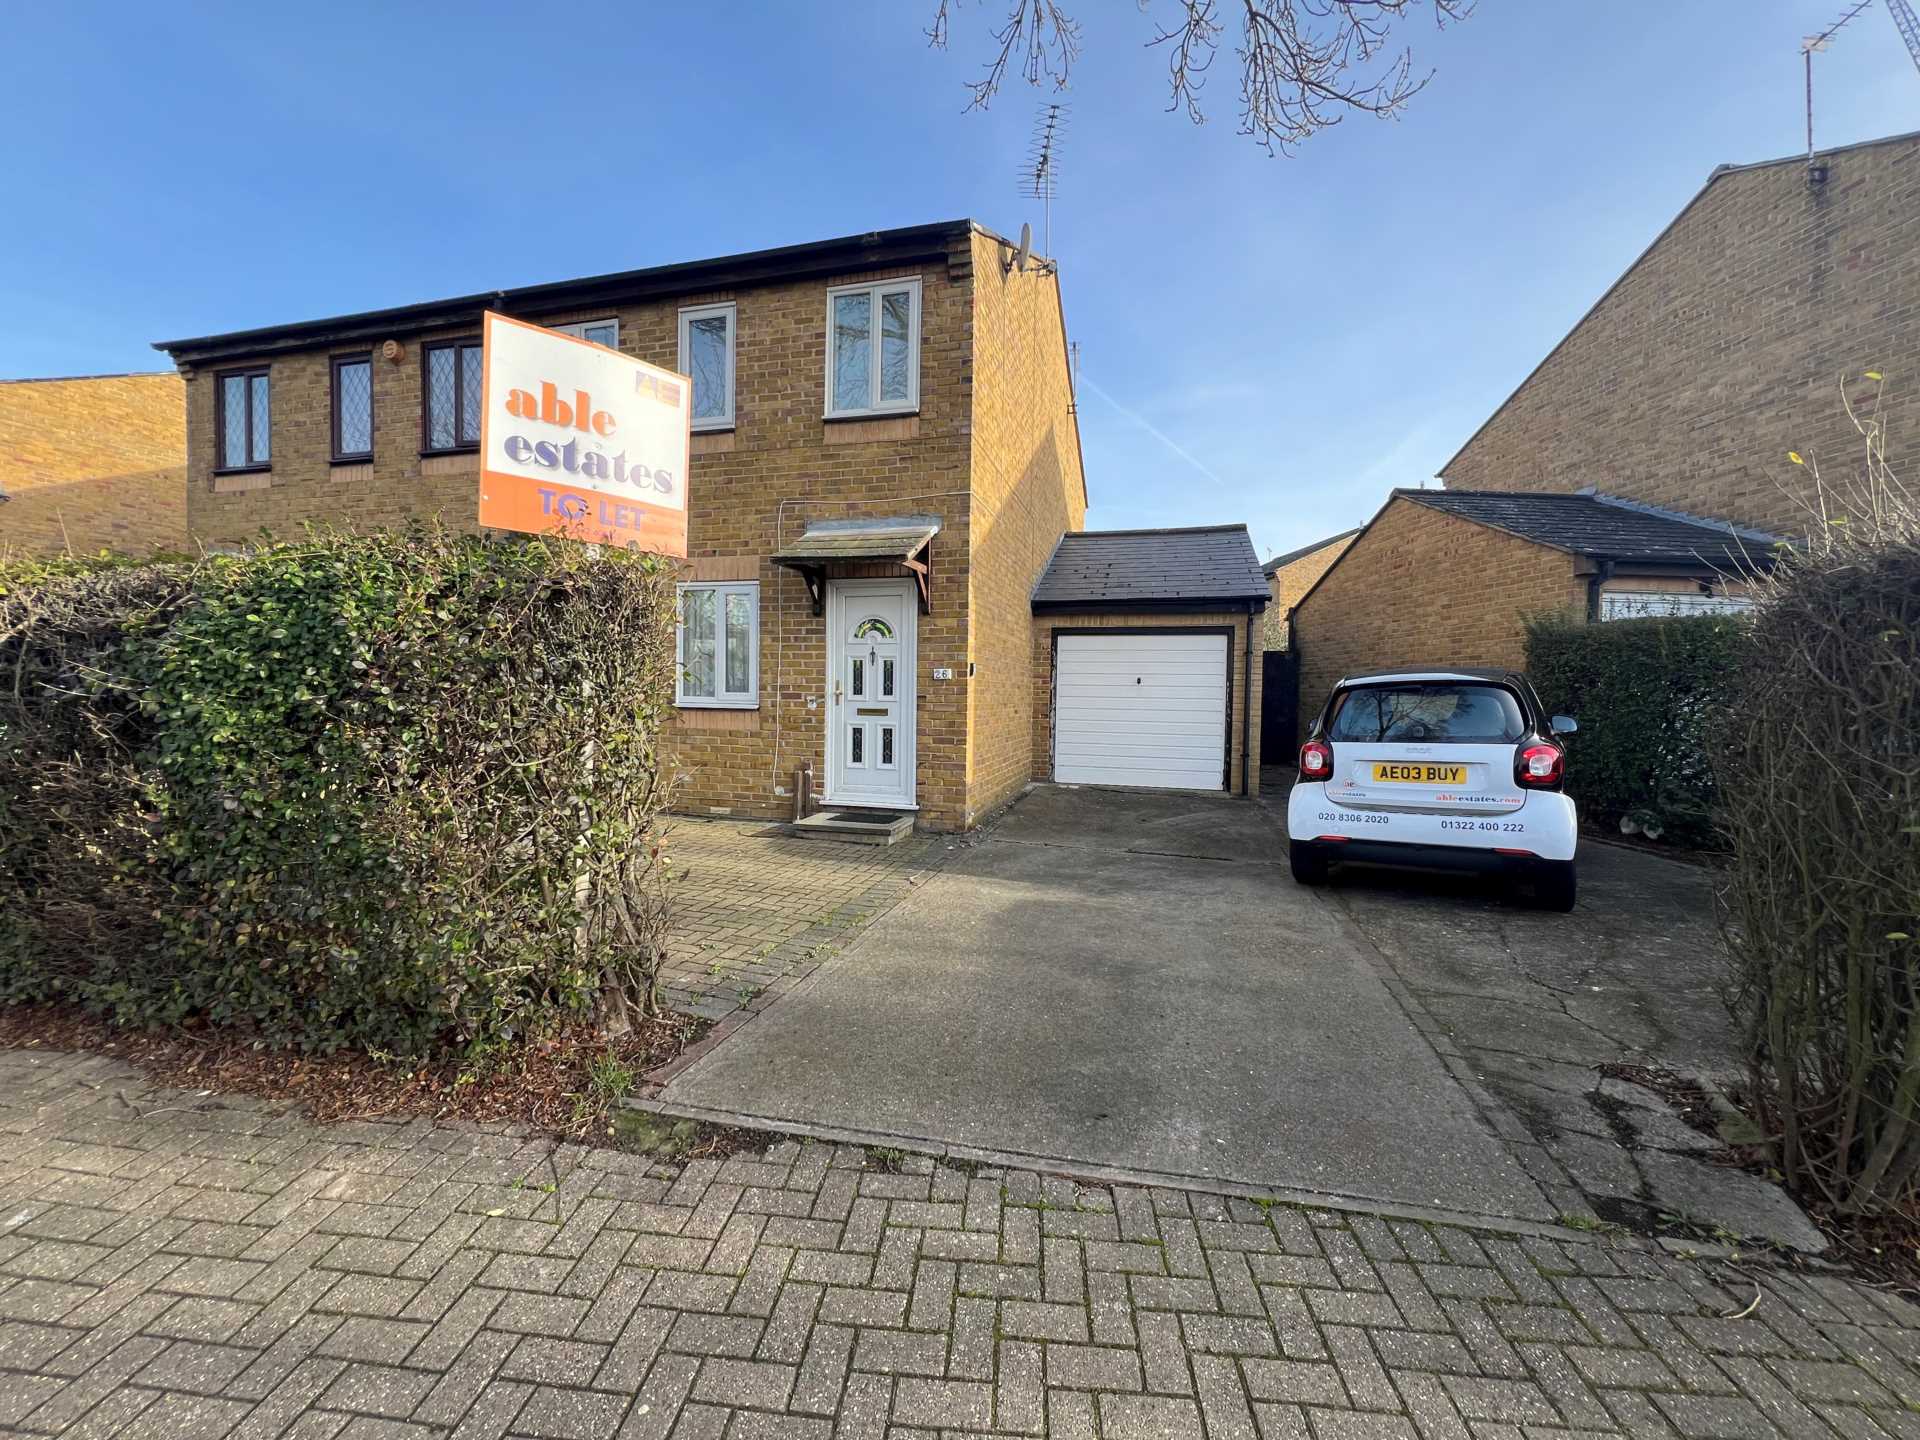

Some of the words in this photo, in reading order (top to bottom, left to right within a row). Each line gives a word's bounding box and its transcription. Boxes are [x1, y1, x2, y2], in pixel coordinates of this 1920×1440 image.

[505, 380, 617, 437] able
[504, 436, 673, 494] estates
[538, 488, 587, 520] TO
[600, 500, 647, 532] LET
[1380, 766, 1421, 780] AE03
[1427, 767, 1460, 781] BUY
[1318, 812, 1336, 821] 020
[1338, 813, 1362, 822] 8306
[1365, 815, 1389, 824] 2020
[1441, 820, 1475, 830] 01322
[1478, 822, 1499, 831] 400
[1503, 823, 1525, 833] 222
